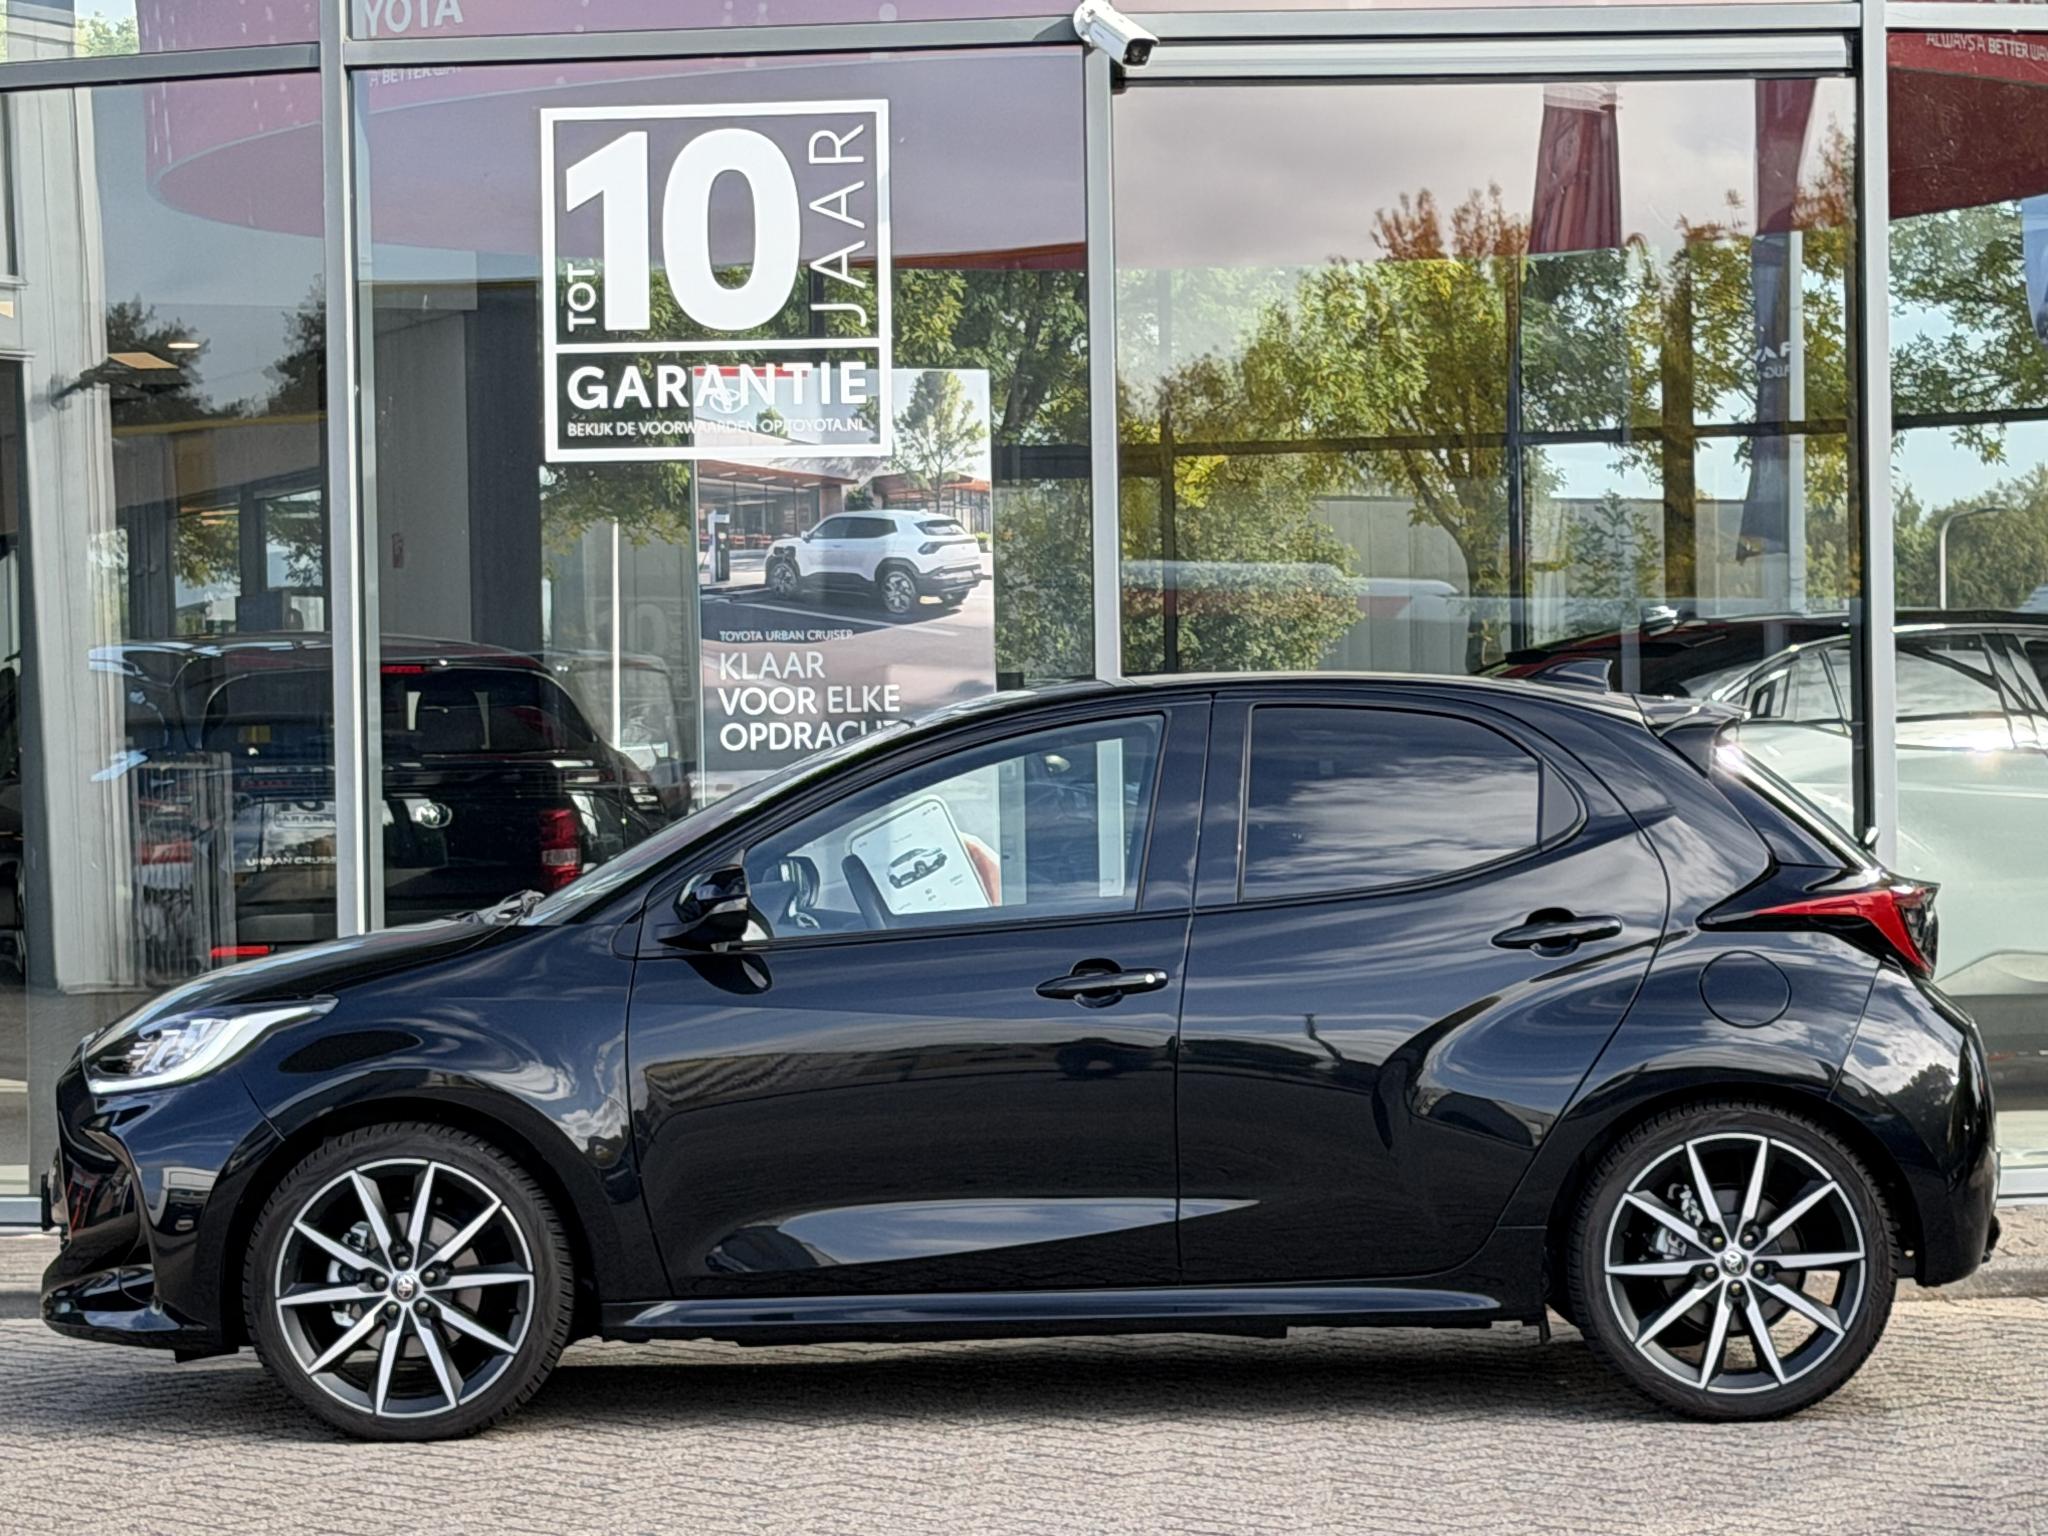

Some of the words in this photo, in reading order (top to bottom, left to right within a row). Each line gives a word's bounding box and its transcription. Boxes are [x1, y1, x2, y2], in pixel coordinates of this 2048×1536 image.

[1925, 33, 1976, 53] ALWAYS
[1987, 37, 2029, 58] BETTER
[2029, 43, 2048, 61] WA
[566, 127, 801, 331] 10
[809, 123, 868, 328] JAAR
[567, 262, 598, 332] TOT
[567, 361, 867, 410] GARANTIE
[567, 421, 613, 437] BEKIJK
[616, 421, 637, 436] DE
[760, 418, 784, 433] OP
[785, 418, 867, 433] TOYOTA.NL
[719, 630, 763, 642] TOYOTA
[766, 630, 805, 641] URBAN
[807, 629, 854, 641] CRUISER
[719, 651, 826, 681] KLAAR
[717, 686, 818, 716] VOOR
[827, 684, 901, 714] ELKE
[719, 719, 903, 751] OPDRAC
